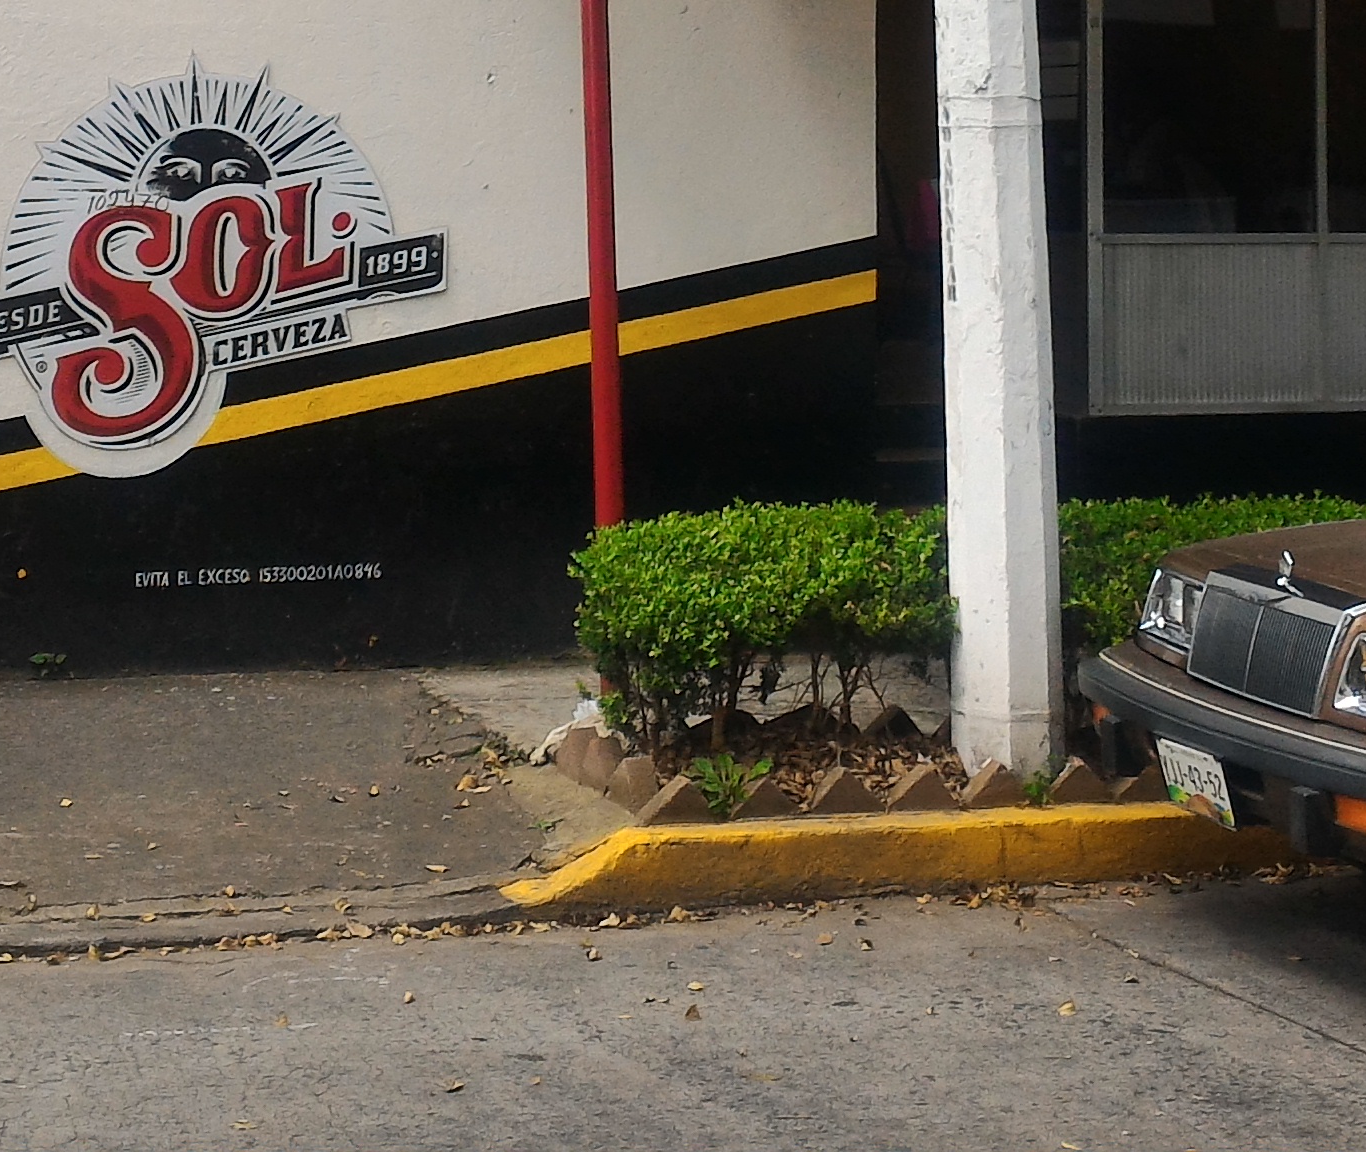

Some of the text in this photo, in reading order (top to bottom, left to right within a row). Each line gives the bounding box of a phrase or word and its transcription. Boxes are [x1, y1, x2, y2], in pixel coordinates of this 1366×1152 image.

[365, 245, 428, 278] 1899
[51, 182, 355, 438] SOL
[211, 312, 350, 368] CERVEZA
[135, 570, 170, 589] EVITA
[177, 569, 193, 586] EL
